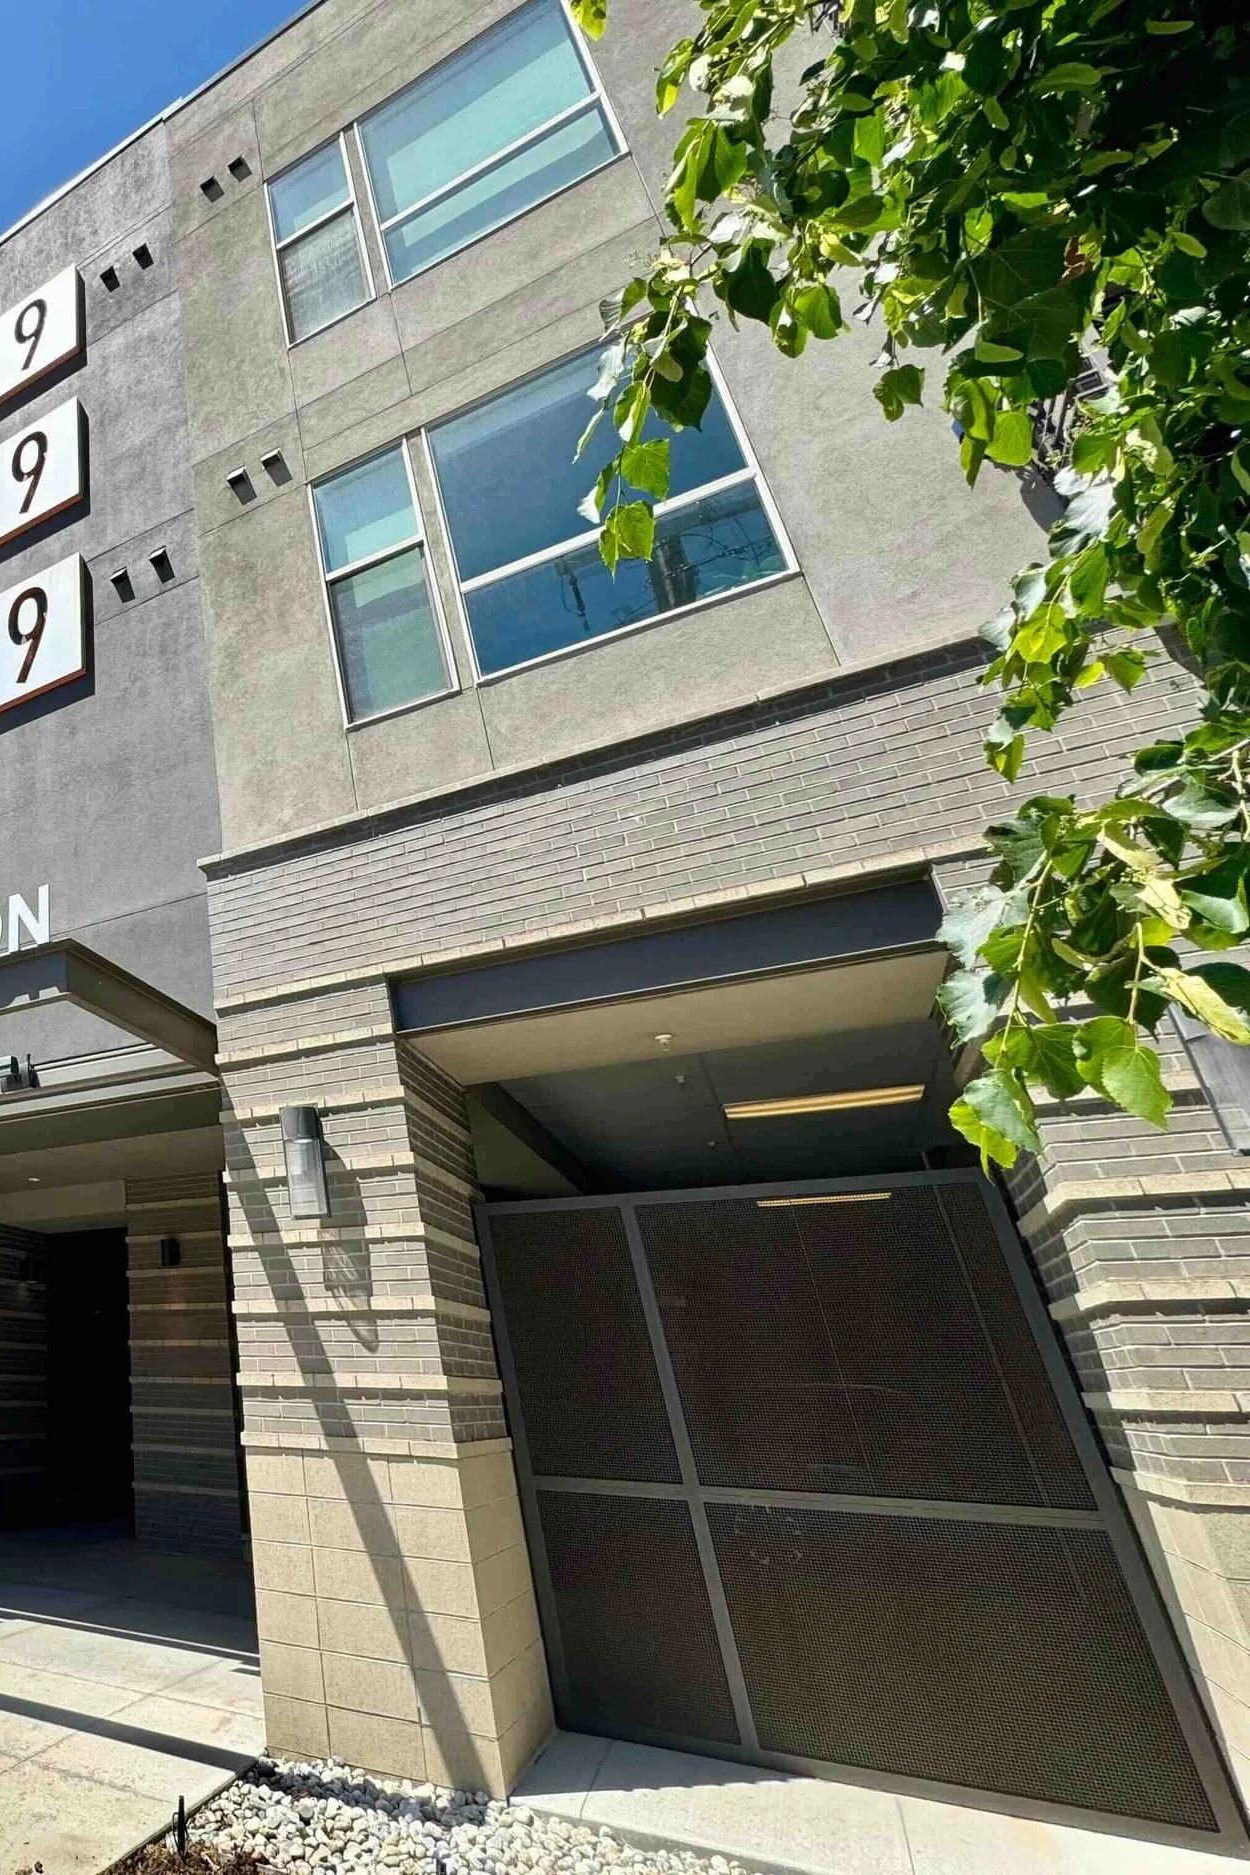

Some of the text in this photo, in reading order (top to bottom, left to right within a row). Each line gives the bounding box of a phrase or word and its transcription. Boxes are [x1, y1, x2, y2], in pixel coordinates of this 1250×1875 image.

[14, 298, 48, 371] 9
[11, 430, 48, 515] 9
[7, 586, 48, 684] 9
